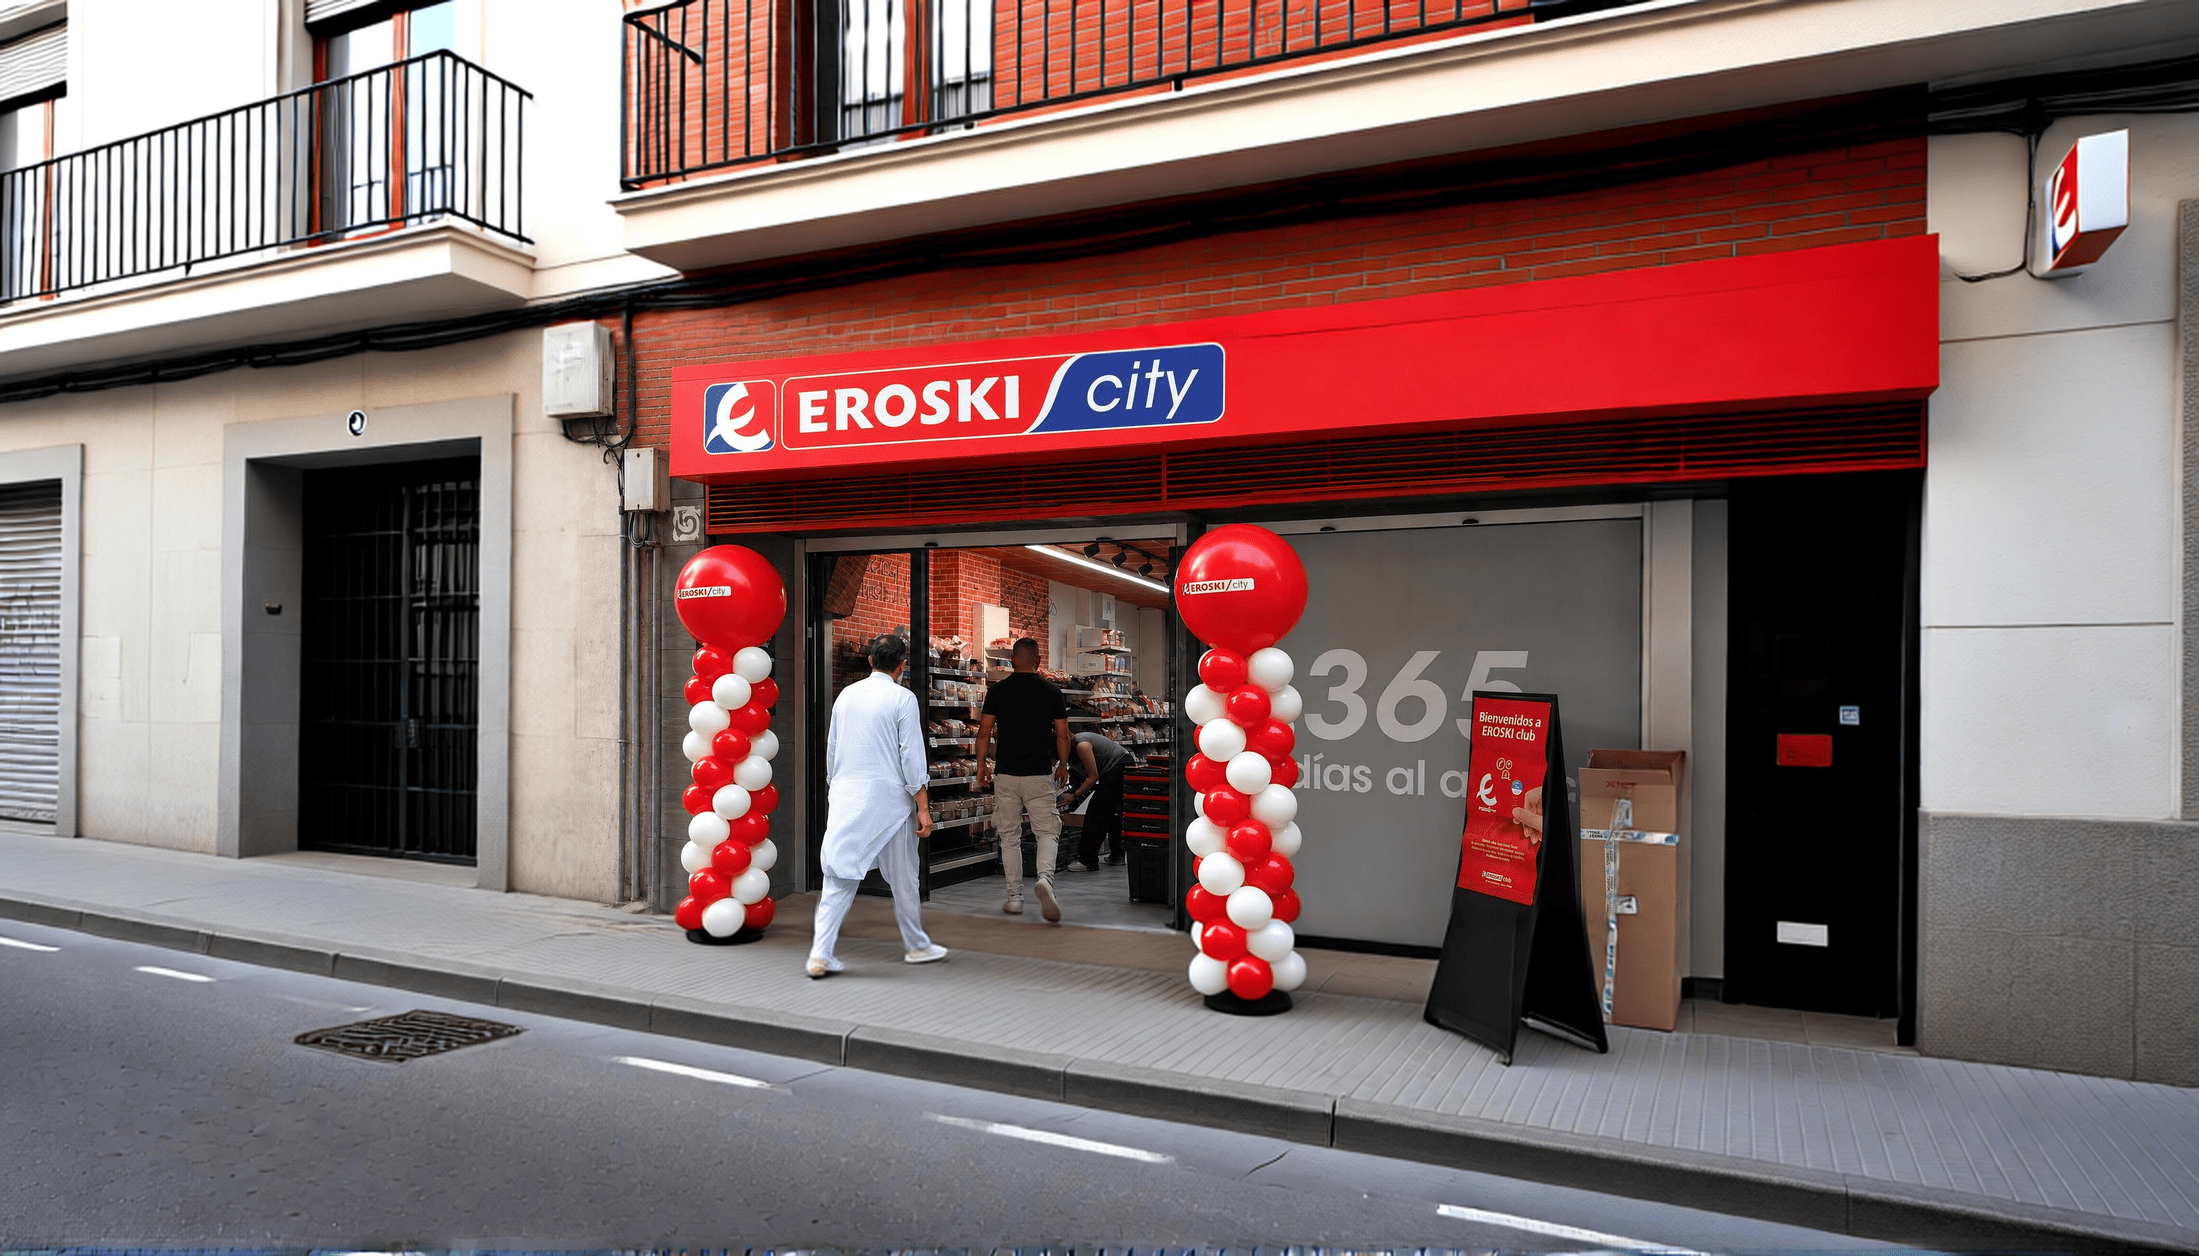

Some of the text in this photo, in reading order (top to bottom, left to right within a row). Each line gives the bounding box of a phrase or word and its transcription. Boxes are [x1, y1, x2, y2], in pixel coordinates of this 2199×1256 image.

[799, 375, 1019, 434] EROSKI
[1087, 359, 1199, 420] city
[1304, 648, 1529, 742] 365
[1479, 711, 1542, 728] Bienvenidos a
[1482, 725, 1536, 742] EROSKI club
[1293, 752, 1373, 793] días
[1385, 759, 1426, 796] al
